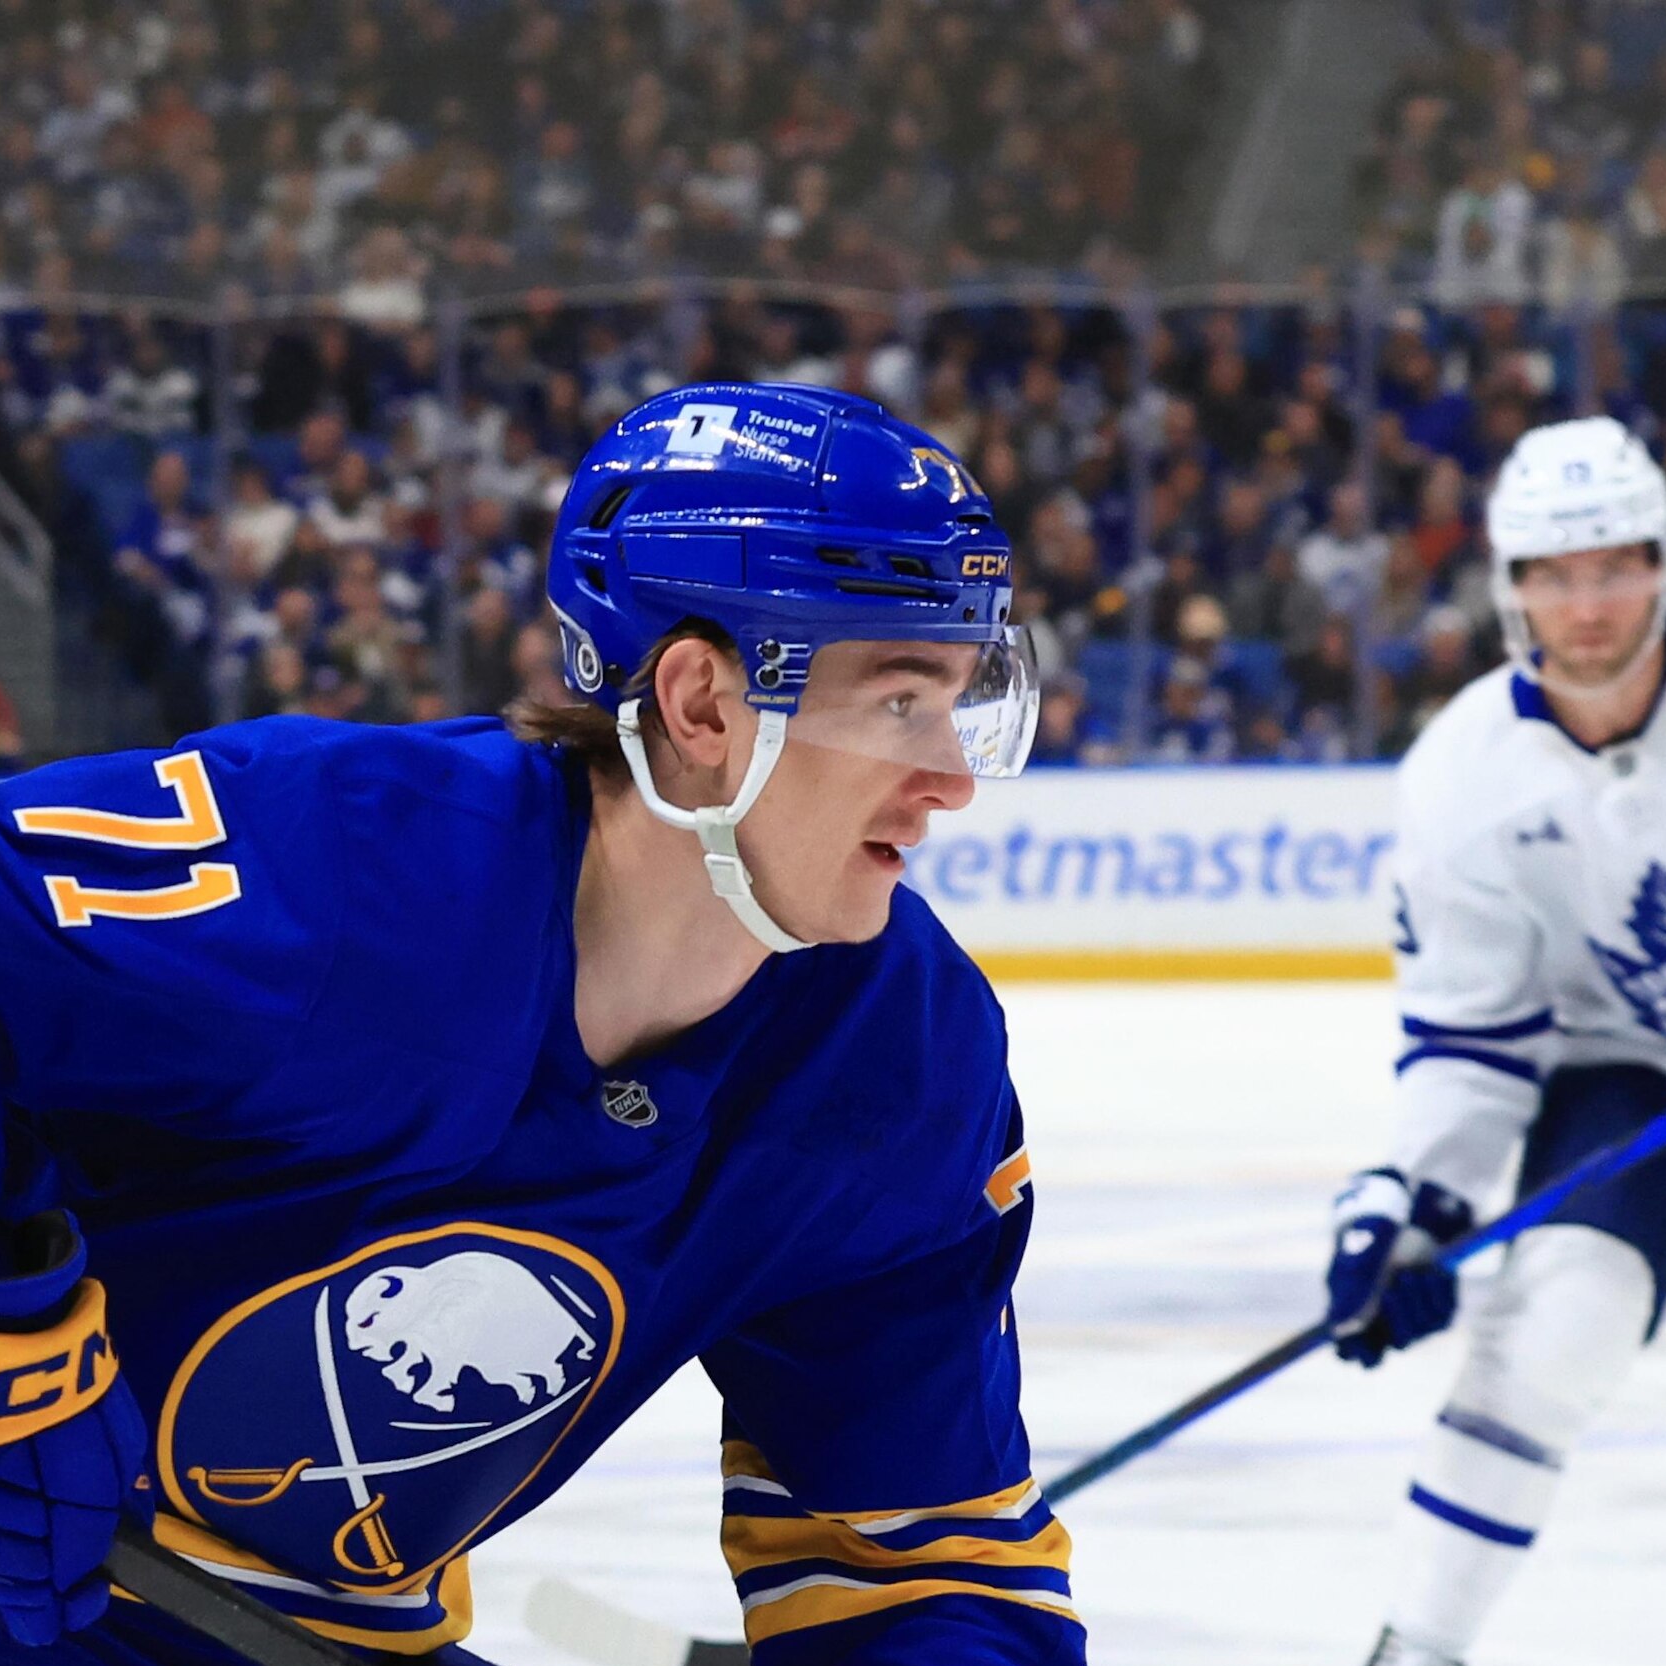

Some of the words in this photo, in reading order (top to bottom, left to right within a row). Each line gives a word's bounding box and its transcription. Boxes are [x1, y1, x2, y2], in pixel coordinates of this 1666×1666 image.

[739, 425, 790, 447] Nurse
[748, 410, 817, 437] Trusted
[12, 749, 242, 928] 71
[613, 1090, 642, 1115] NHL
